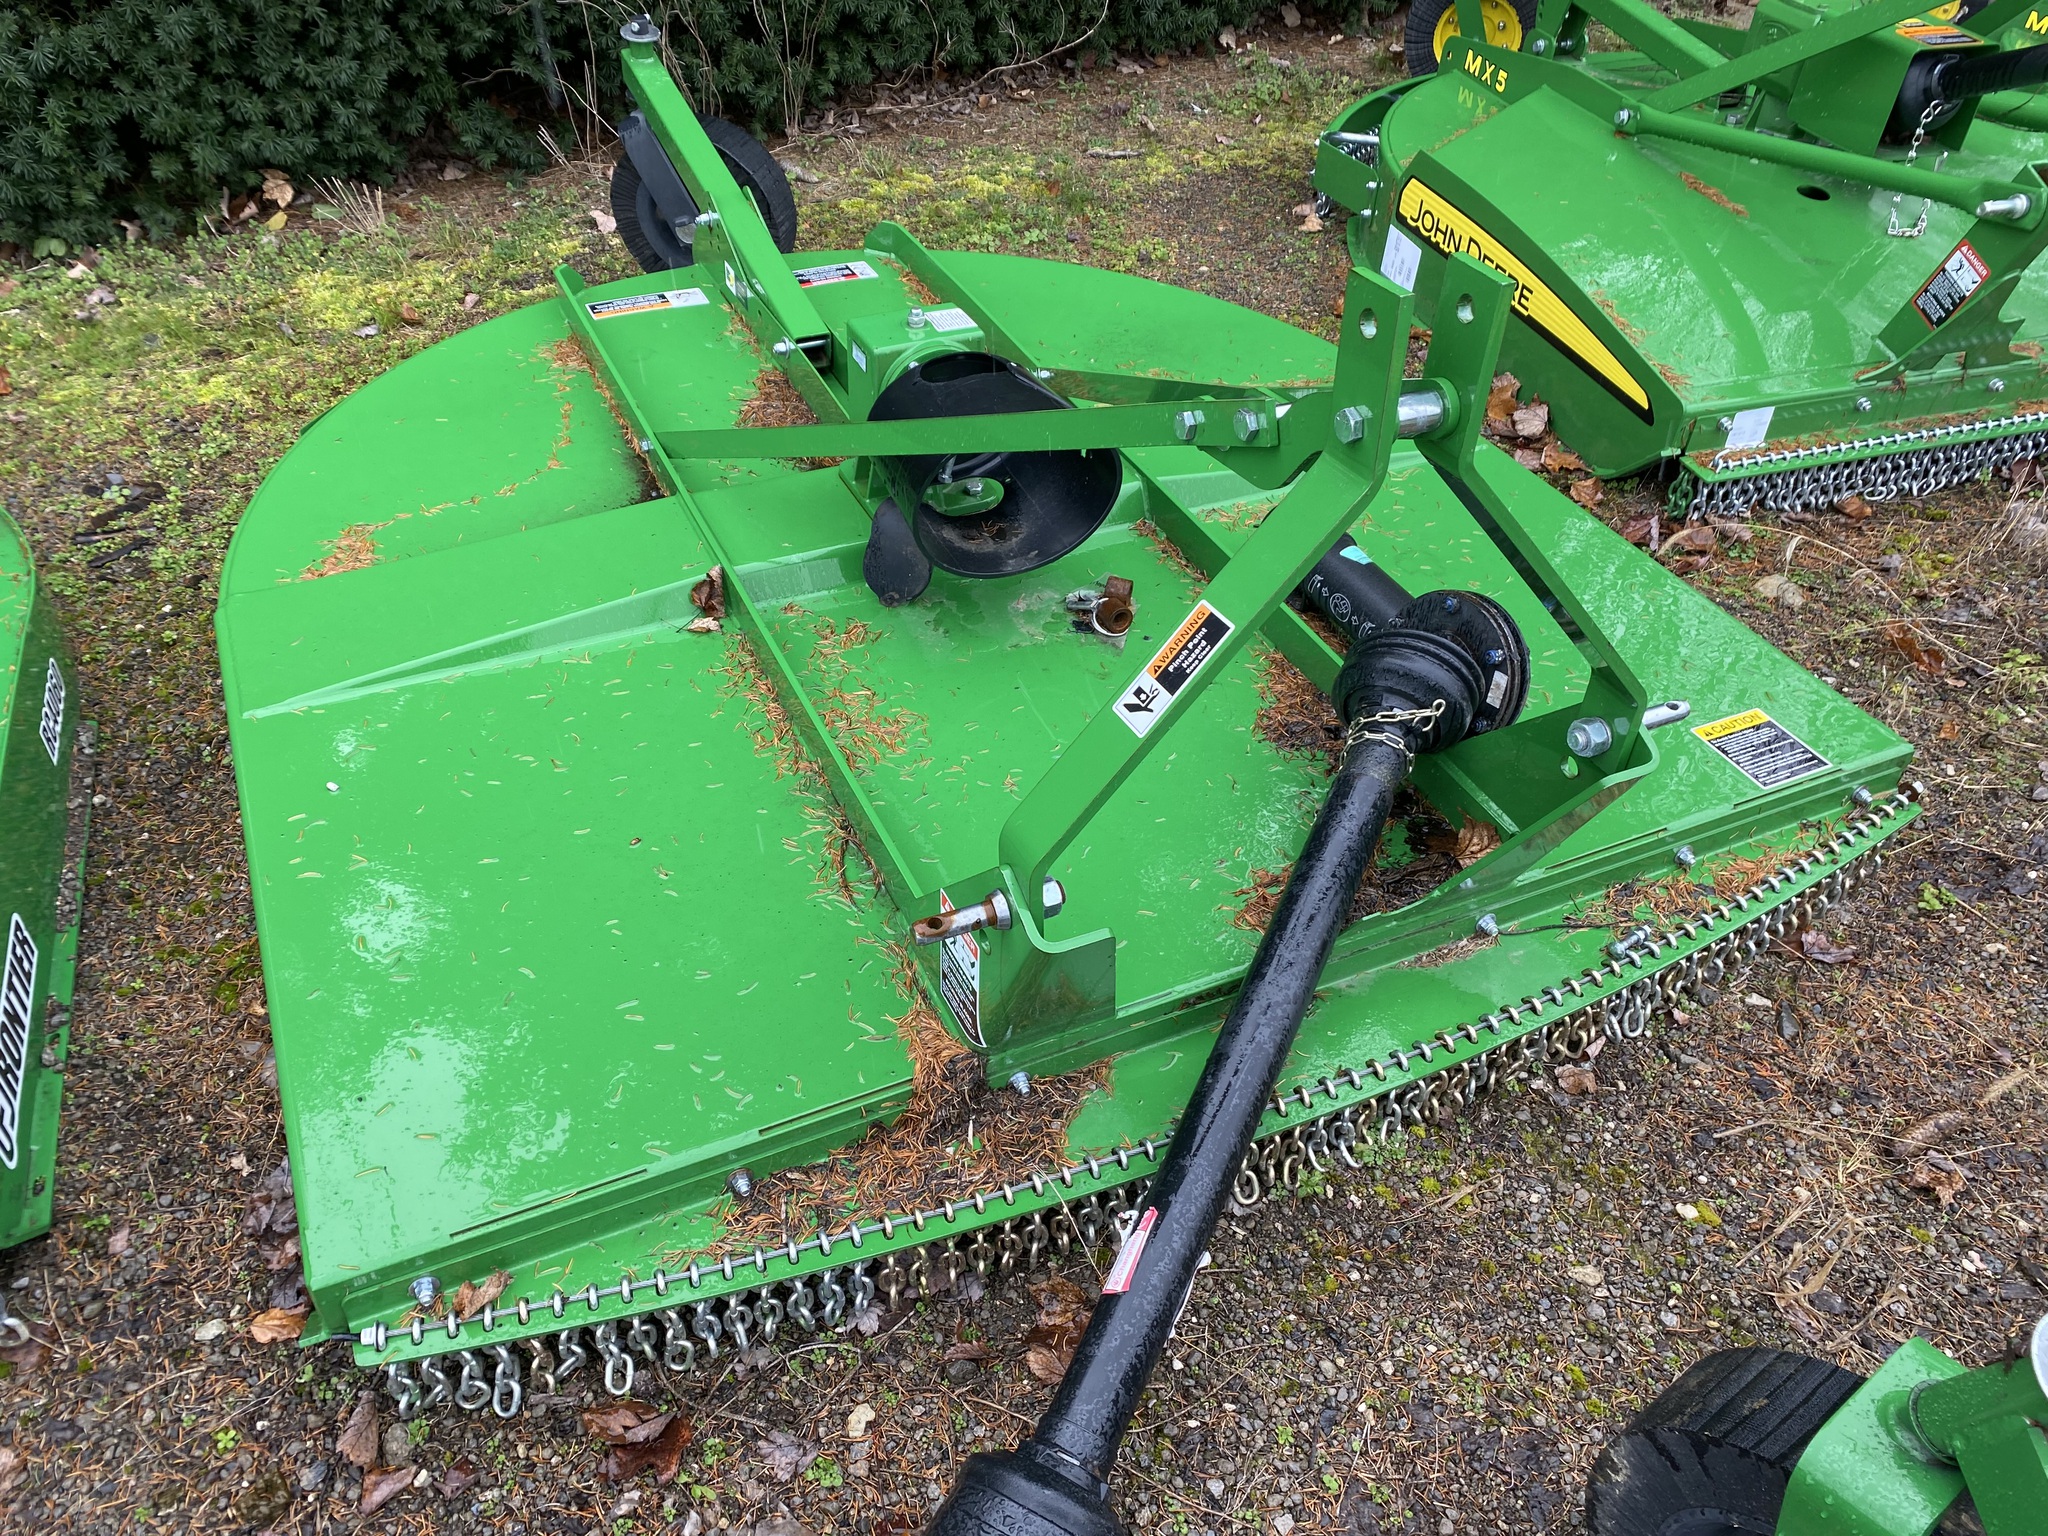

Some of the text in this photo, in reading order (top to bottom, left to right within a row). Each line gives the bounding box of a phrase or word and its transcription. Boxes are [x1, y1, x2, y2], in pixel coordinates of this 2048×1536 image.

[1464, 48, 1508, 93] MX5
[1409, 199, 1463, 253] JOHN
[1465, 236, 1534, 312] DRE
[1966, 250, 1988, 278] DANGER
[1159, 610, 1206, 664] WARNING
[1167, 627, 1208, 673] Pinch Point
[1181, 640, 1207, 669] Hazard
[1185, 645, 1212, 674] Keep Clear
[1711, 713, 1761, 735] CAUTION
